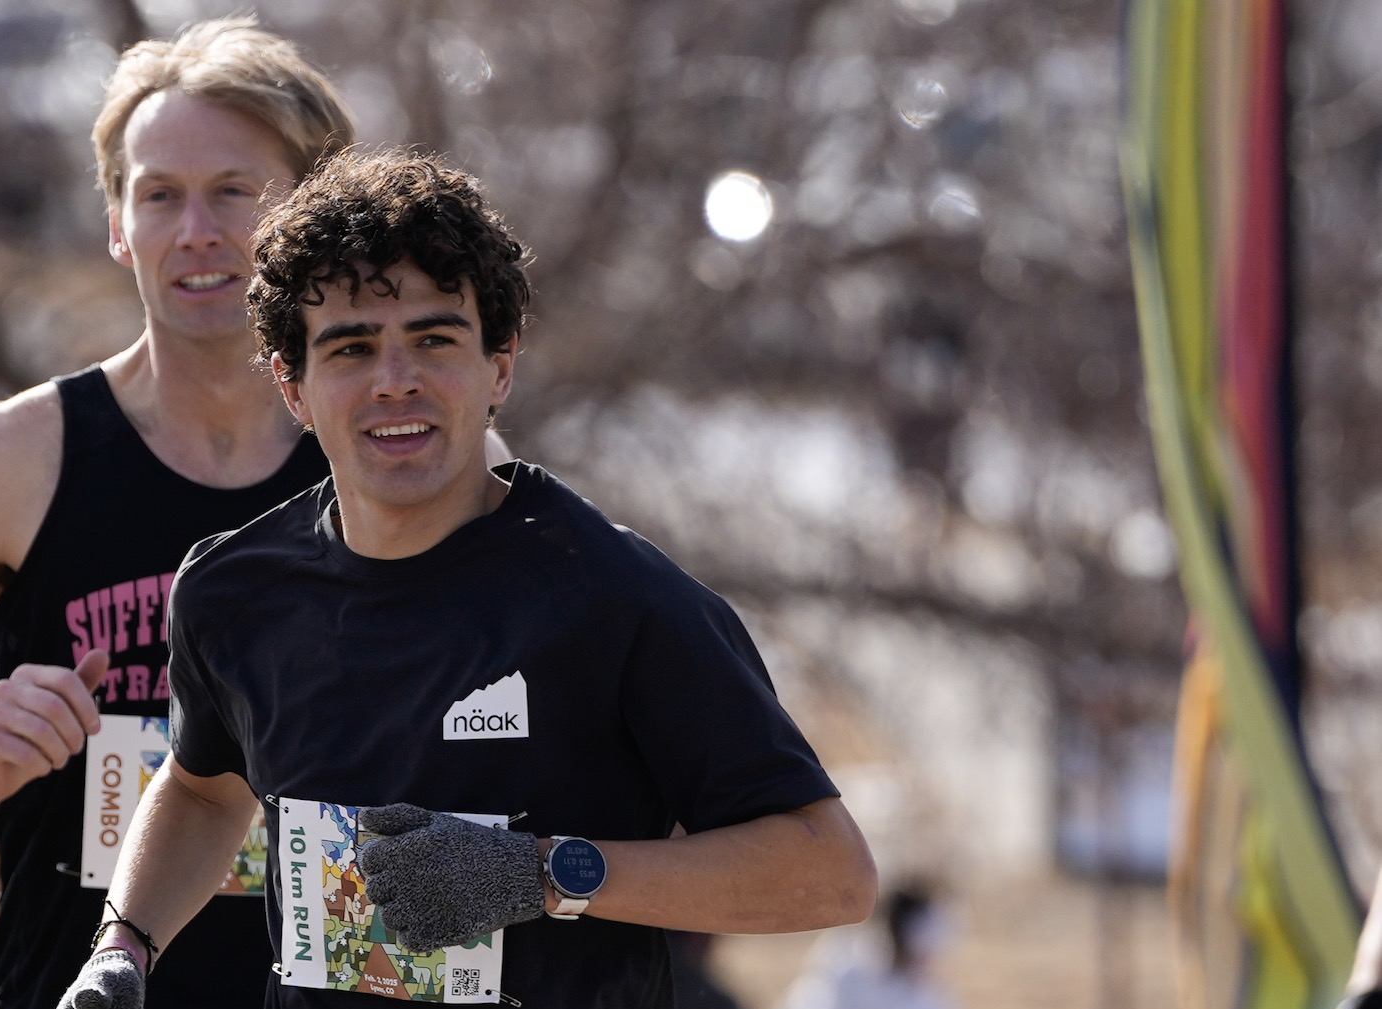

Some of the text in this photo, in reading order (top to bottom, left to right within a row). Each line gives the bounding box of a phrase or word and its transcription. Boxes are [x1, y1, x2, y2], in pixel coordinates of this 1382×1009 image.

[454, 709, 519, 732] näak
[100, 754, 122, 847] COMBO
[290, 826, 312, 961] 10 km RUN
